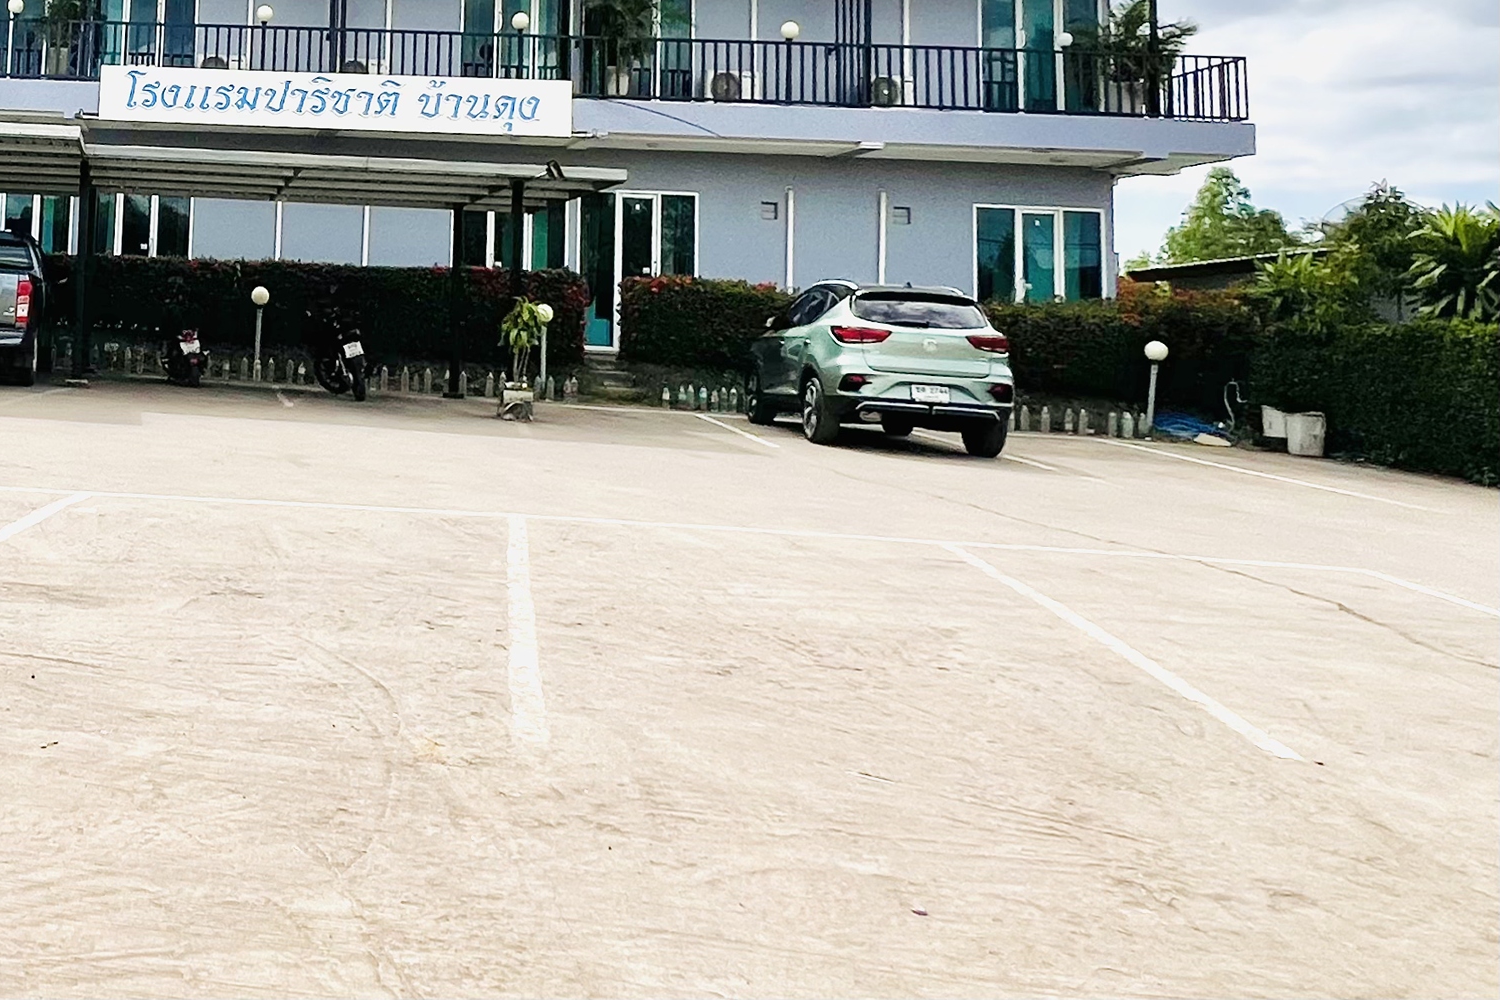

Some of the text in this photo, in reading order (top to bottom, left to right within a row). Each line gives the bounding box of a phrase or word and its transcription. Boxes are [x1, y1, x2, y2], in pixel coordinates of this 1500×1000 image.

[126, 70, 541, 131] โรงแรมปาริชาติ บ้านดุง
